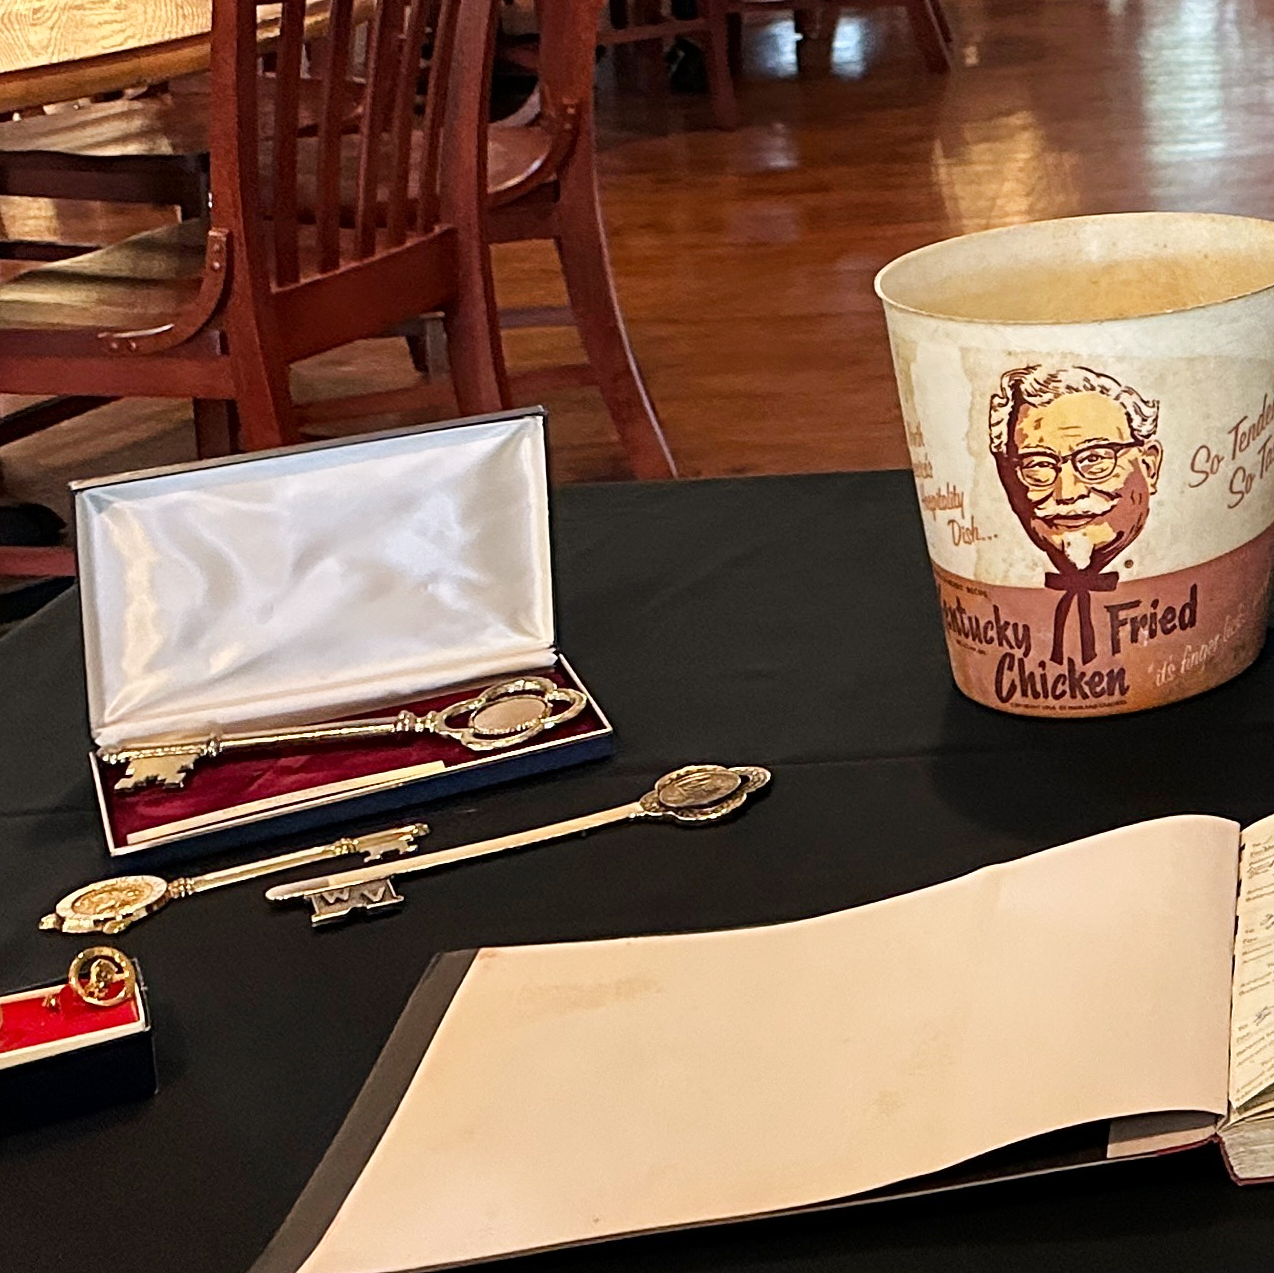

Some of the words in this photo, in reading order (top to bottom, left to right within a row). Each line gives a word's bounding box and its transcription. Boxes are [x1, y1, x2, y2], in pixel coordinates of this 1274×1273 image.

[1187, 444, 1225, 488] So
[1227, 466, 1256, 509] So
[1104, 583, 1198, 656] Fried
[995, 652, 1130, 704] Chicken
